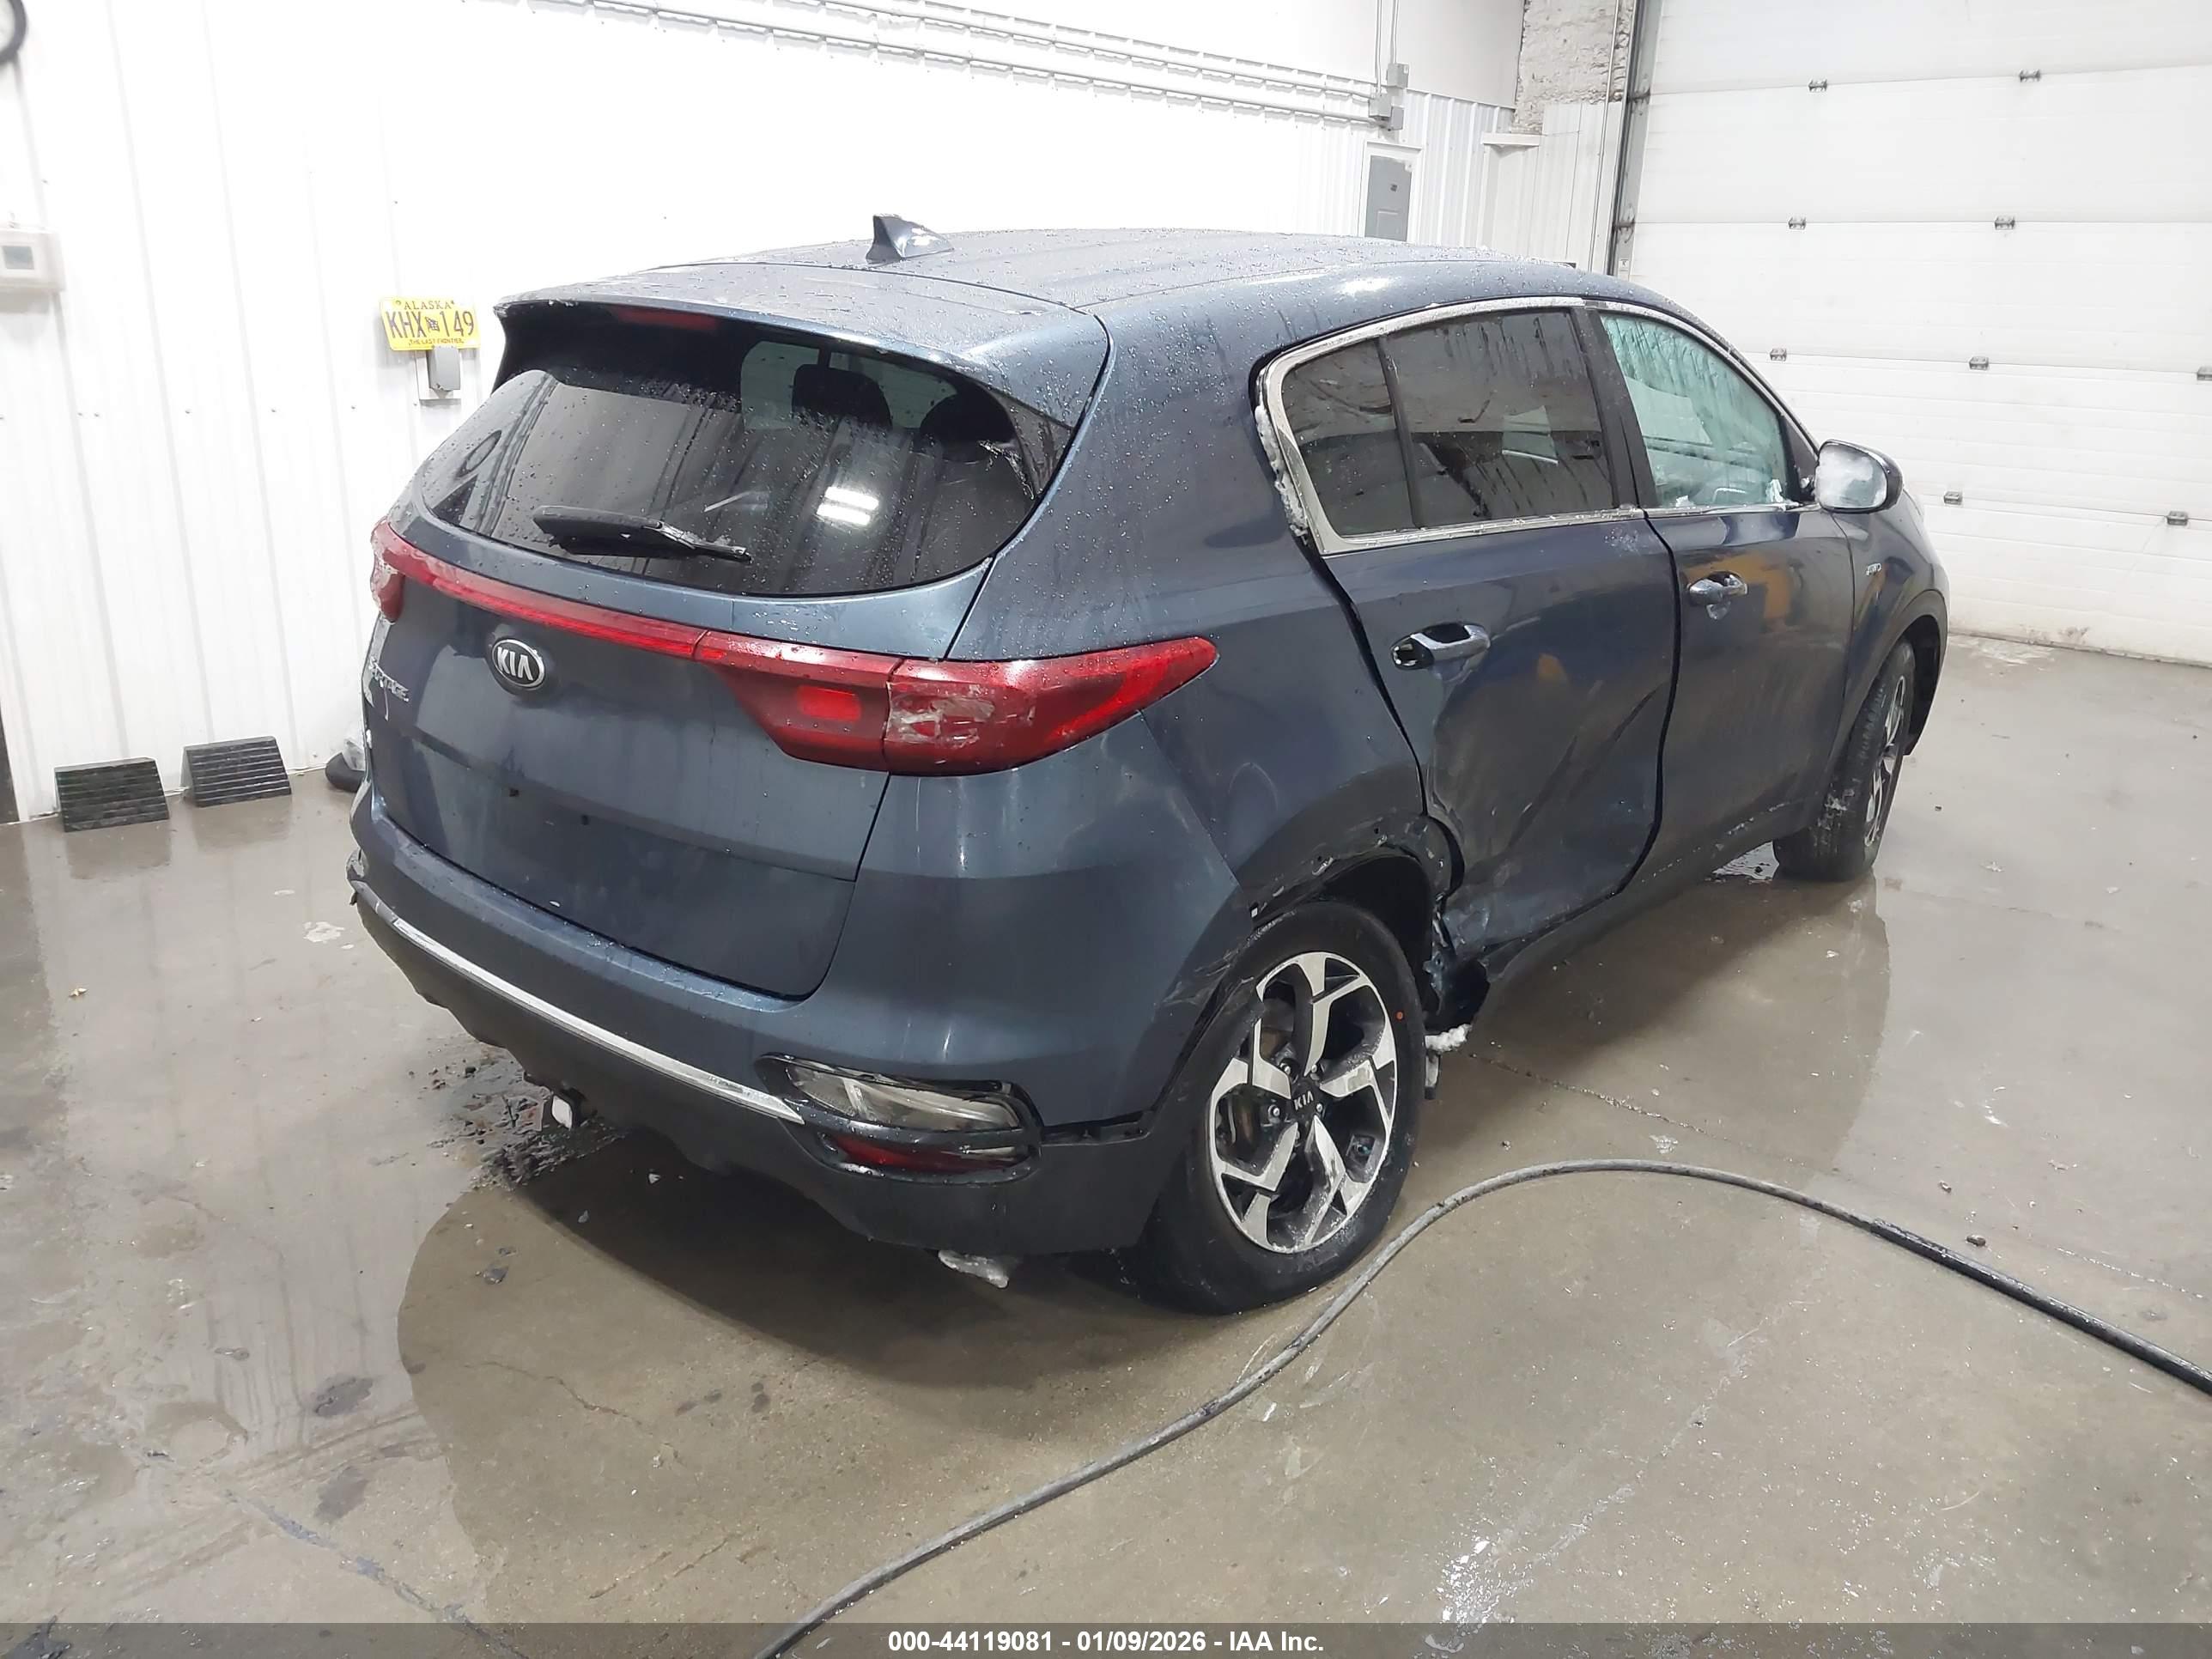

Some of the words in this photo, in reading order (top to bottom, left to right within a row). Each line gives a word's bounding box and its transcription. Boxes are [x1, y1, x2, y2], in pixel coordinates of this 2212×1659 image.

[404, 301, 452, 310] ALASKA
[386, 311, 427, 338] KHX
[440, 310, 474, 337] 149
[497, 647, 534, 681] KIA
[1294, 1091, 1314, 1110] KIA
